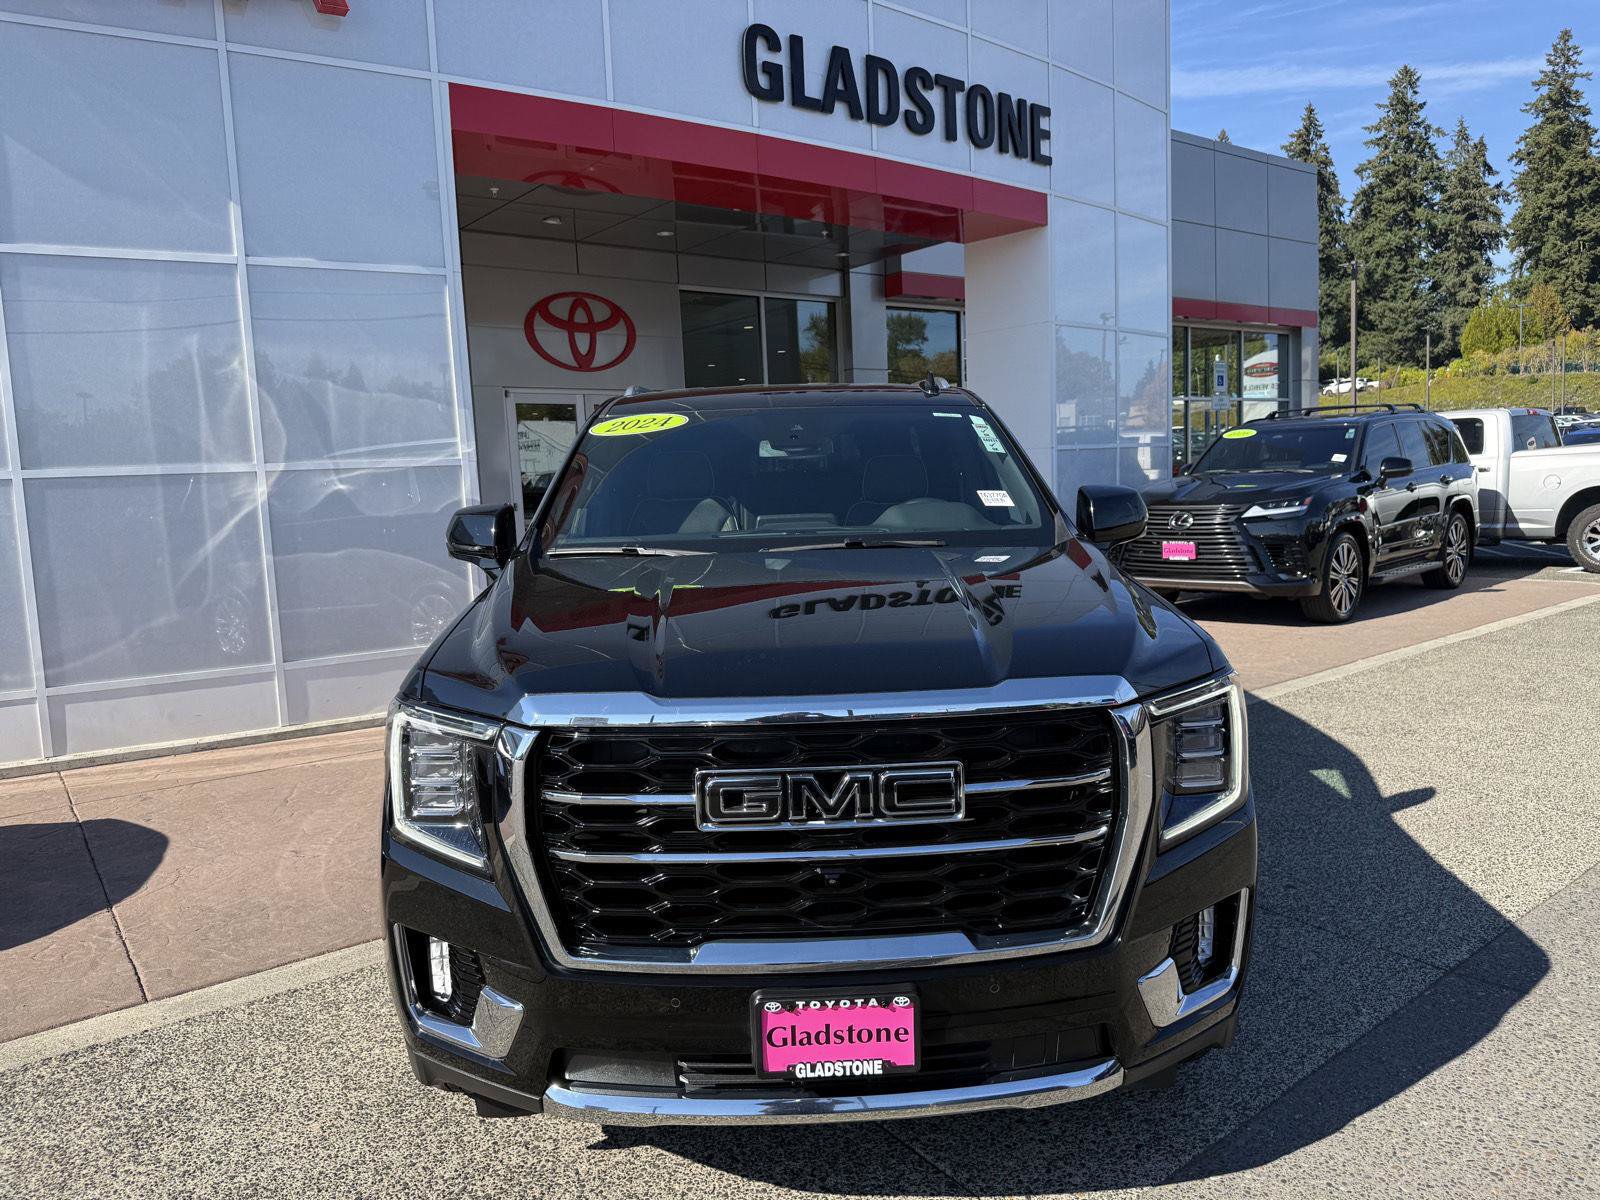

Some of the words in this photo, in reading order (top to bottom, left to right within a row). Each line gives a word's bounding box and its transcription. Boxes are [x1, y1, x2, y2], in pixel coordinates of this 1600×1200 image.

[743, 23, 1052, 166] GLADSTONE
[605, 416, 673, 433] 2024
[705, 768, 955, 822] GMC
[795, 998, 879, 1010] TOYOTA
[766, 1024, 909, 1048] Gladstone
[795, 1060, 883, 1079] GLADSTONE
